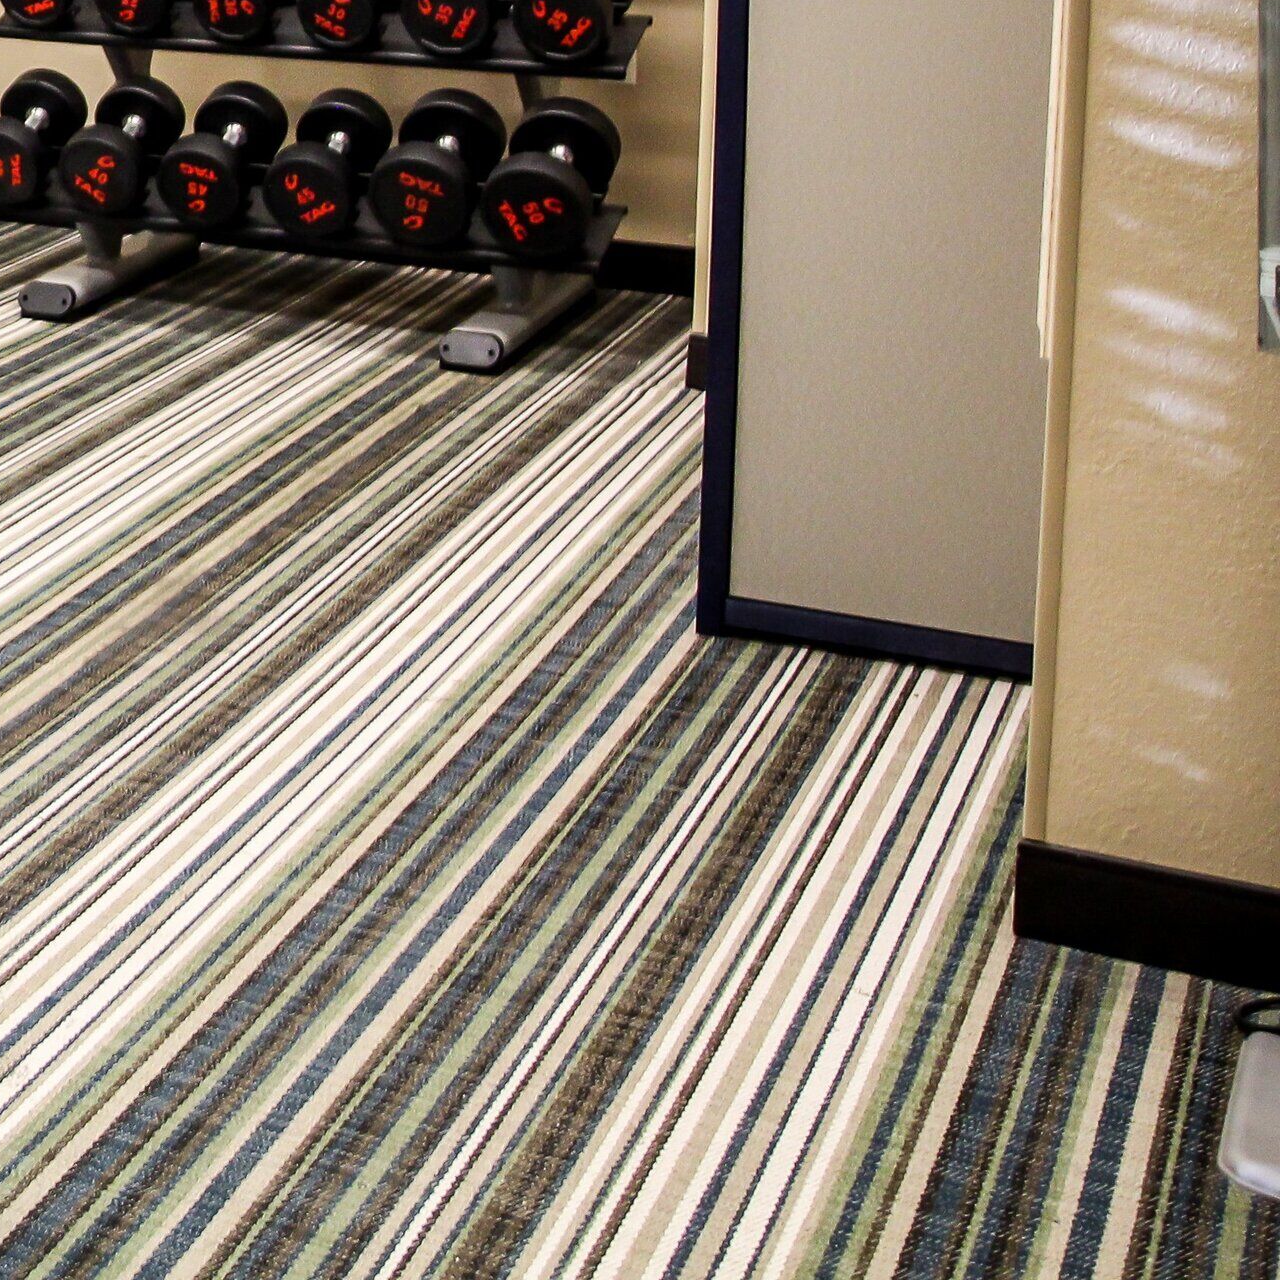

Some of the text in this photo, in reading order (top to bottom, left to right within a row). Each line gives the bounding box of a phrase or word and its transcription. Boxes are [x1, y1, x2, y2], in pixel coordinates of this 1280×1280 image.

[434, 4, 454, 24] 35
[547, 9, 569, 31] 35
[561, 18, 592, 47] TAG
[88, 167, 109, 185] 40
[399, 172, 443, 196] TAG
[74, 175, 105, 203] TAG
[296, 187, 316, 205] 45
[499, 201, 525, 241] TAG
[523, 201, 545, 224] 50
